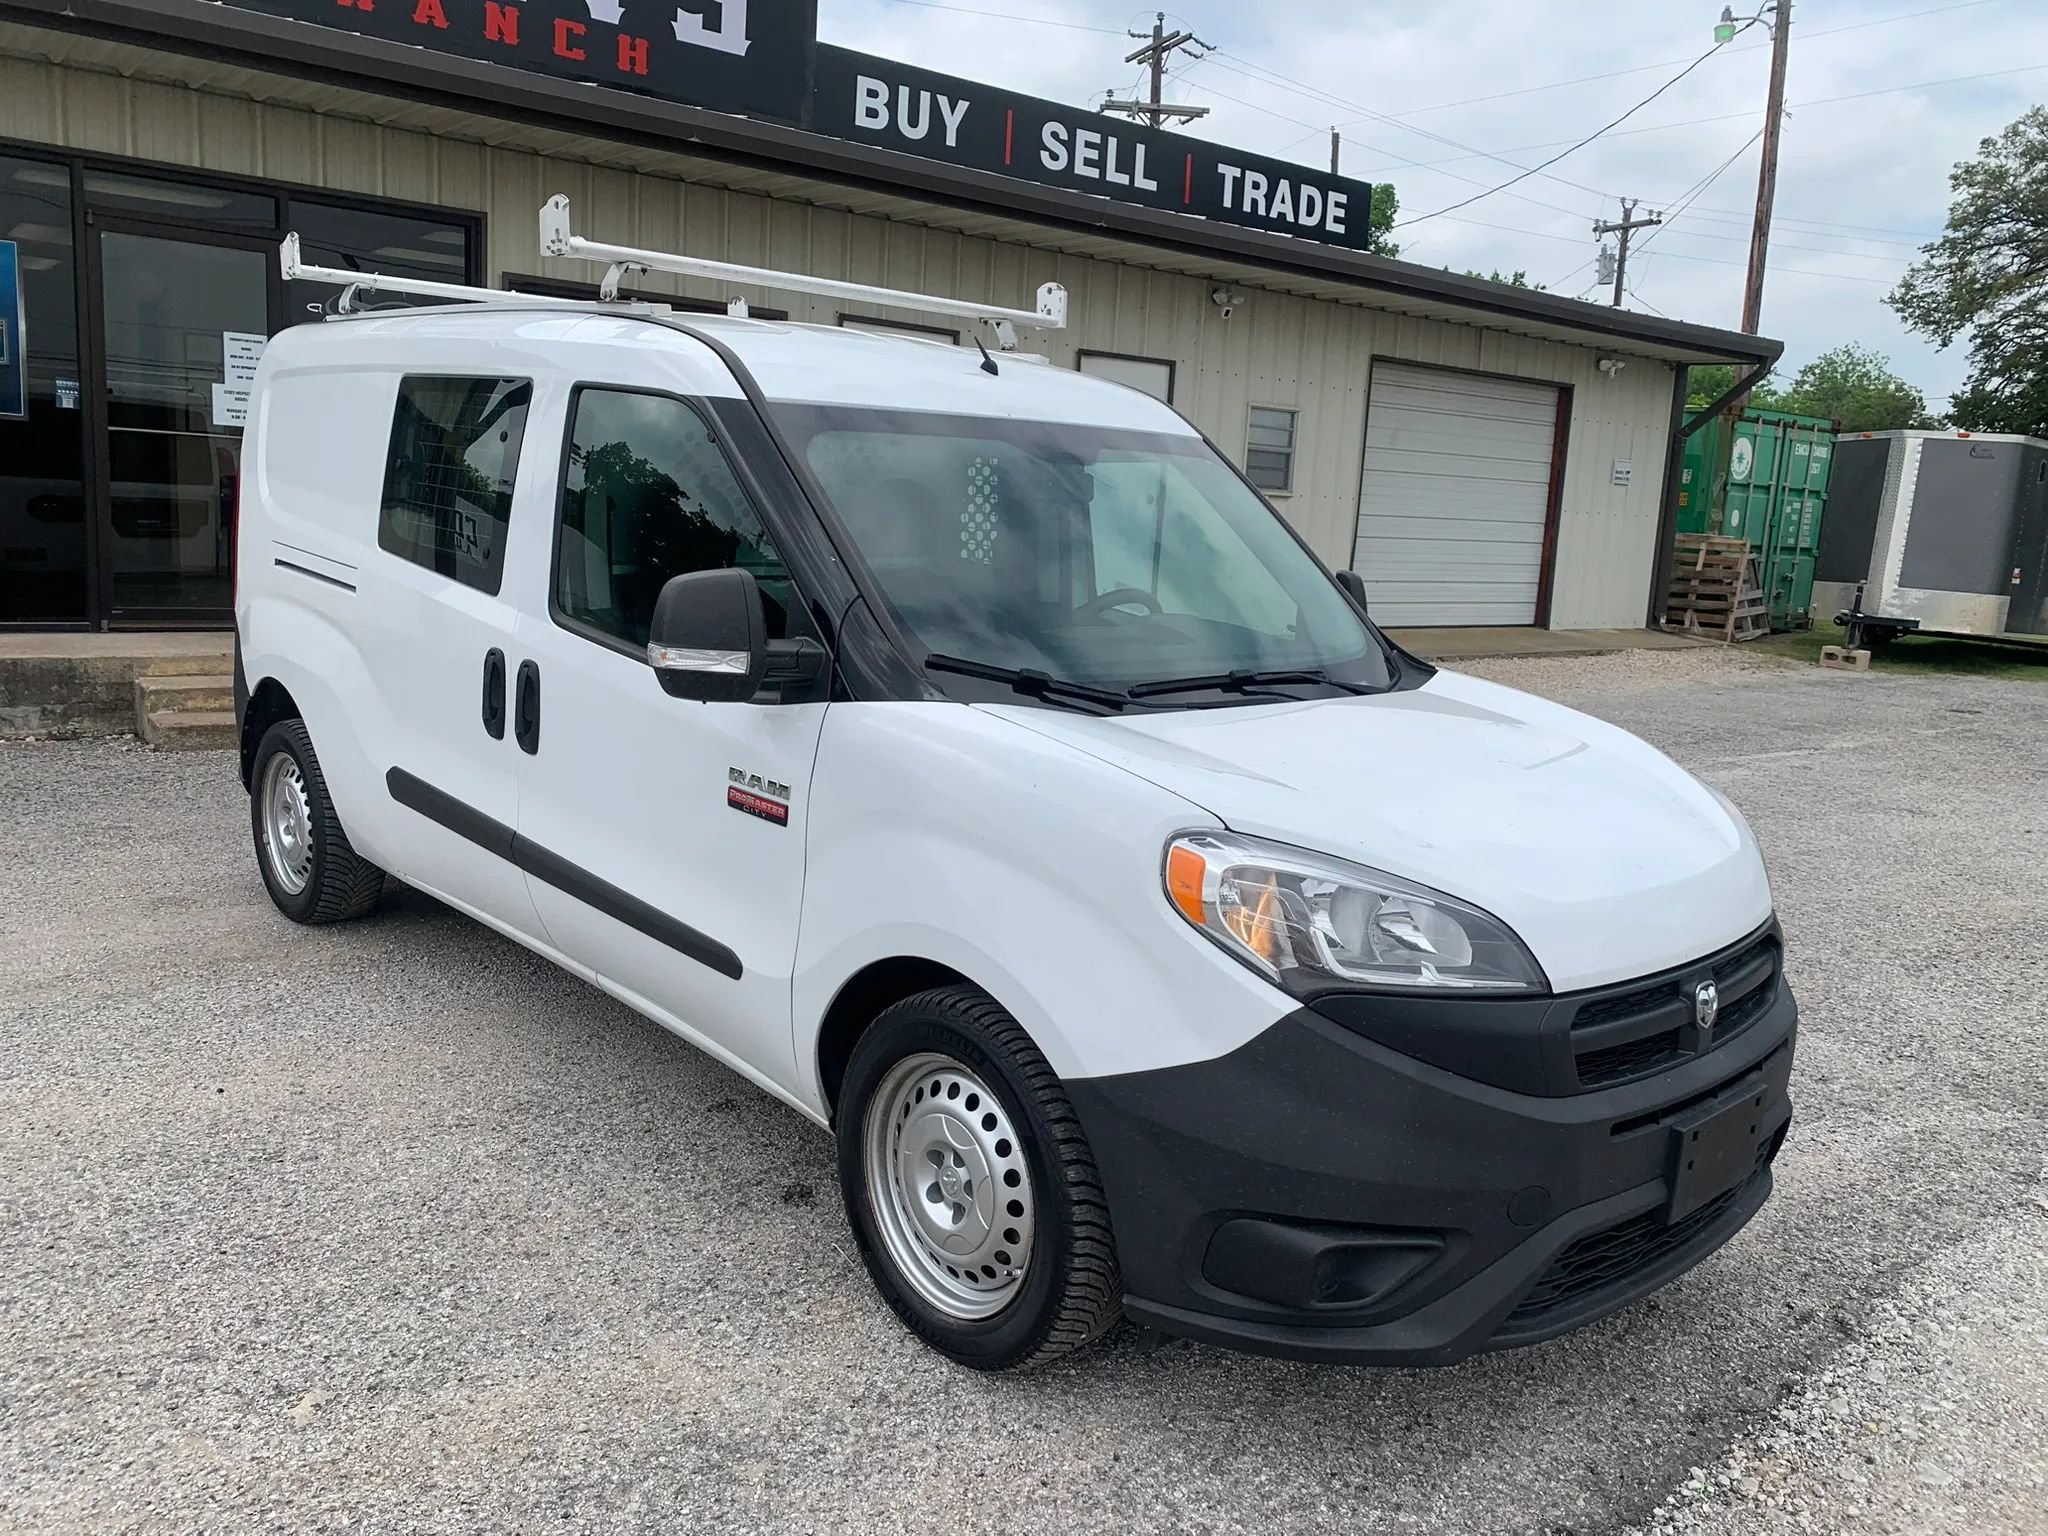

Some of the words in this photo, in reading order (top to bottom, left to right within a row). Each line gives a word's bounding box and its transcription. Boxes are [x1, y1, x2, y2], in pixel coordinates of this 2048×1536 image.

[337, 0, 649, 75] ANCH
[855, 75, 970, 147] BUY
[1040, 121, 1157, 191] SELL
[1217, 163, 1348, 234] TRADE
[728, 765, 791, 801] RAM
[743, 805, 767, 817] CITY
